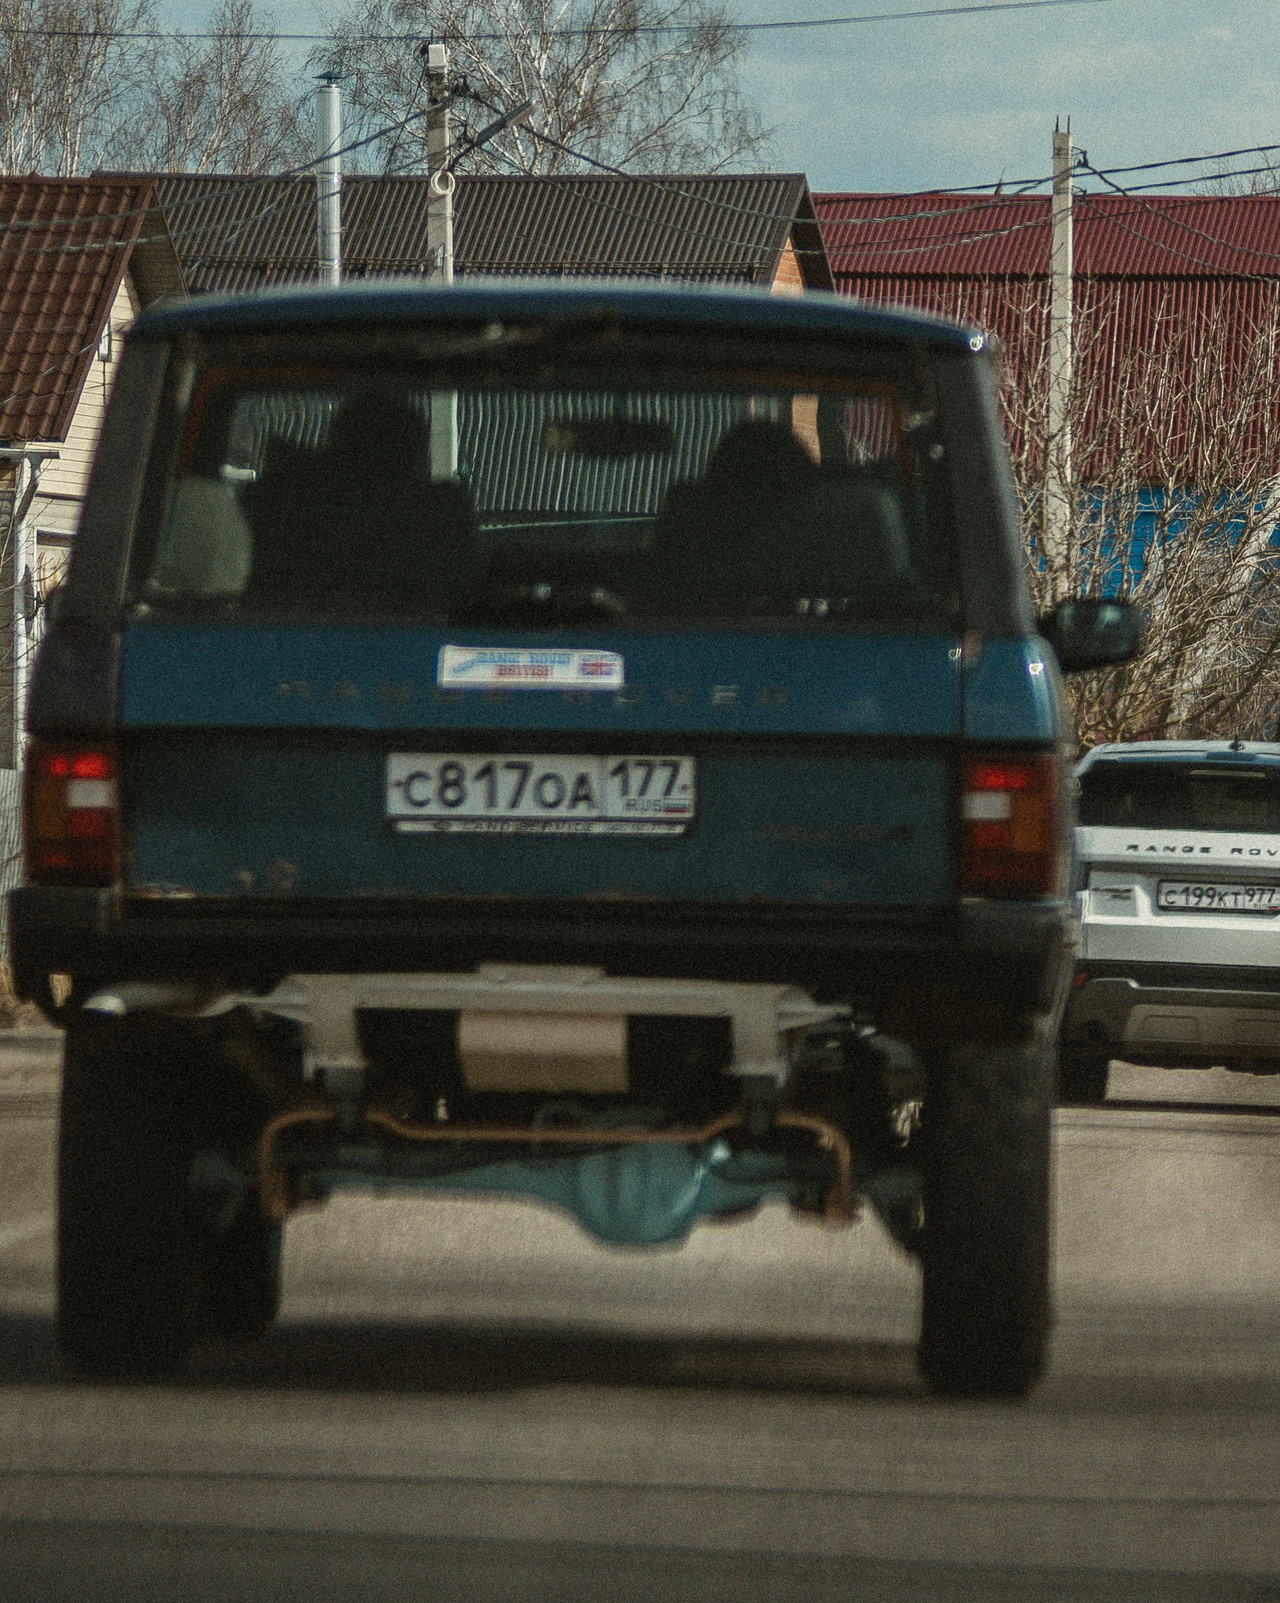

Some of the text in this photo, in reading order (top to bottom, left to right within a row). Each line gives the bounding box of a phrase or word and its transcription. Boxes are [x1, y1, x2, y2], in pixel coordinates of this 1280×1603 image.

[402, 759, 683, 810] С817ОА 177
[1126, 844, 1211, 854] RANGE
[1165, 886, 1276, 908] С199КТ 977
